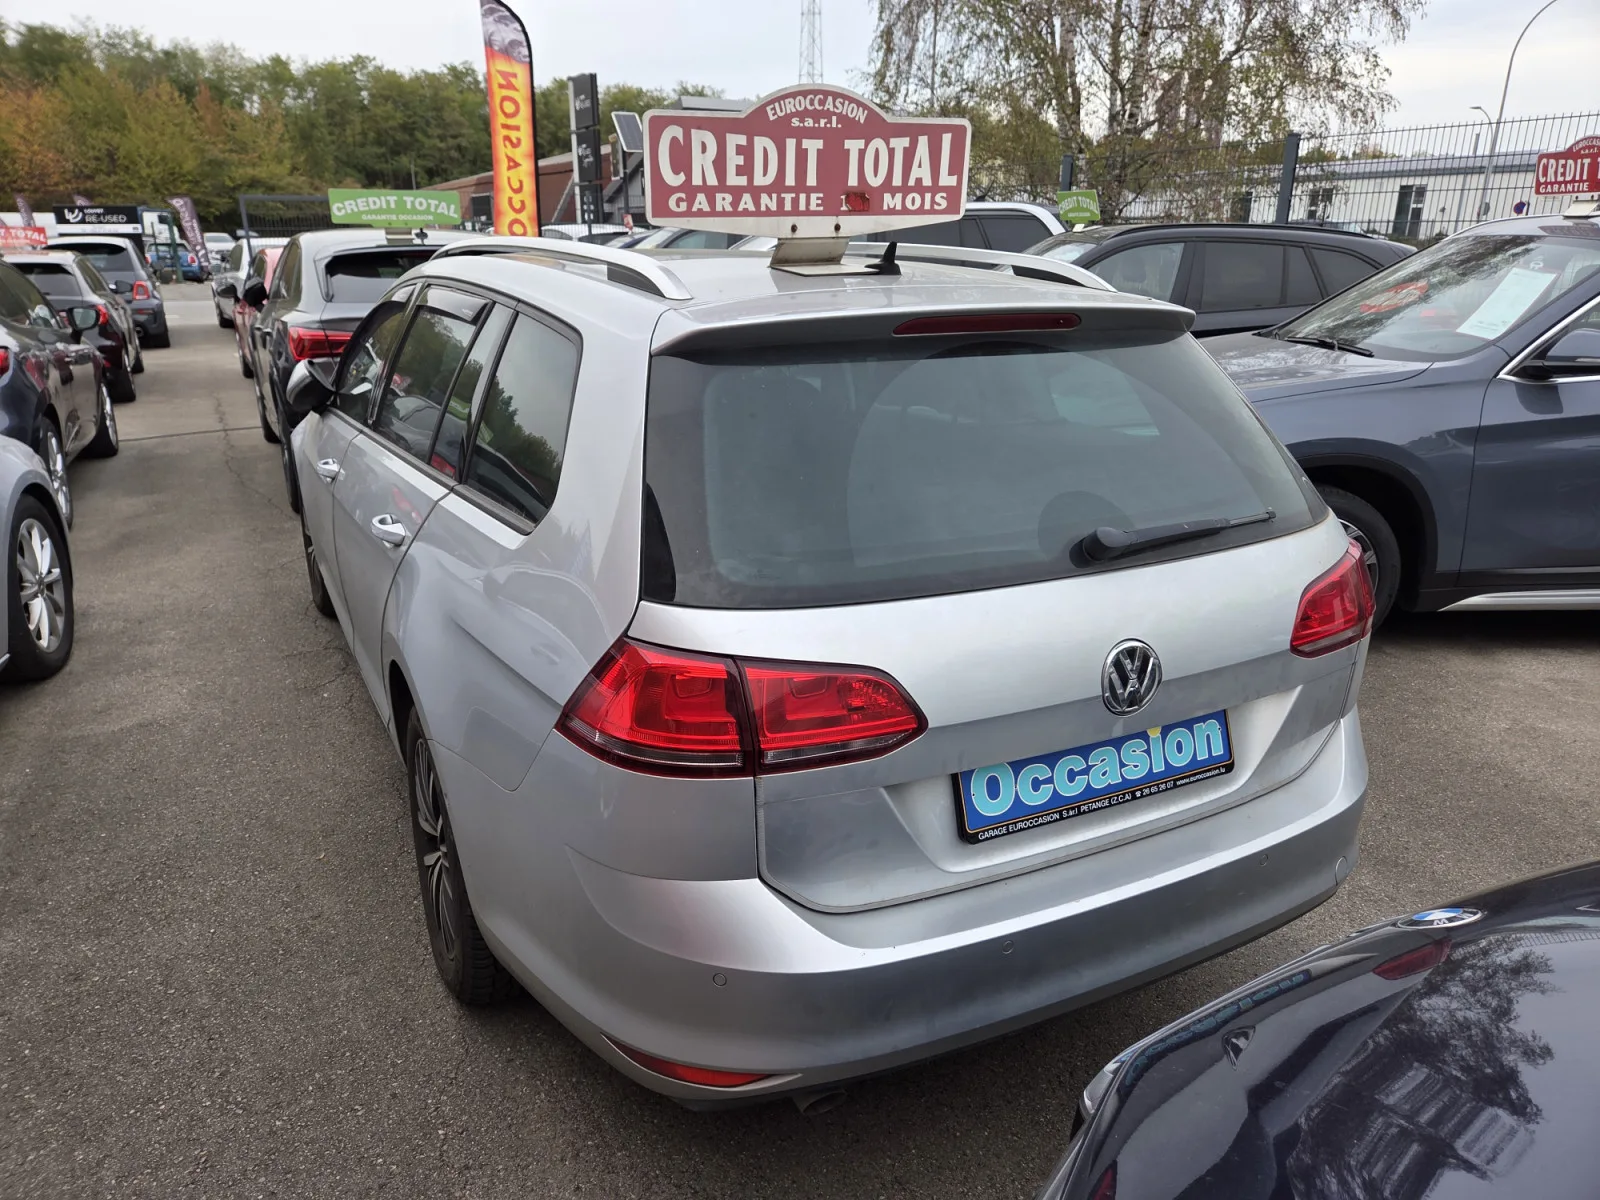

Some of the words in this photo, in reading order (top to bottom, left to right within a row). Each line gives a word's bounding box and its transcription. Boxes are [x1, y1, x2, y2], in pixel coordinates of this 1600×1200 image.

[766, 94, 868, 124] EUROCCASION
[790, 115, 842, 128] s.a.r.l.
[658, 124, 824, 188] CREDIT
[843, 132, 958, 187] TOTAL
[1538, 158, 1591, 183] CREDIT
[1539, 183, 1589, 193] GARANTIE
[332, 195, 398, 217] CREDIT
[403, 195, 459, 218] TOTAL
[668, 192, 824, 212] GARANTIE
[882, 192, 949, 211] MOIS
[971, 718, 1224, 817] Occasion
[978, 825, 1008, 840] GARAGE
[1008, 812, 1060, 832] EUROCCASION
[1080, 799, 1110, 812] PETANGE
[1142, 788, 1150, 796] 26
[1159, 783, 1167, 791] 26
[1166, 780, 1174, 789] 07
